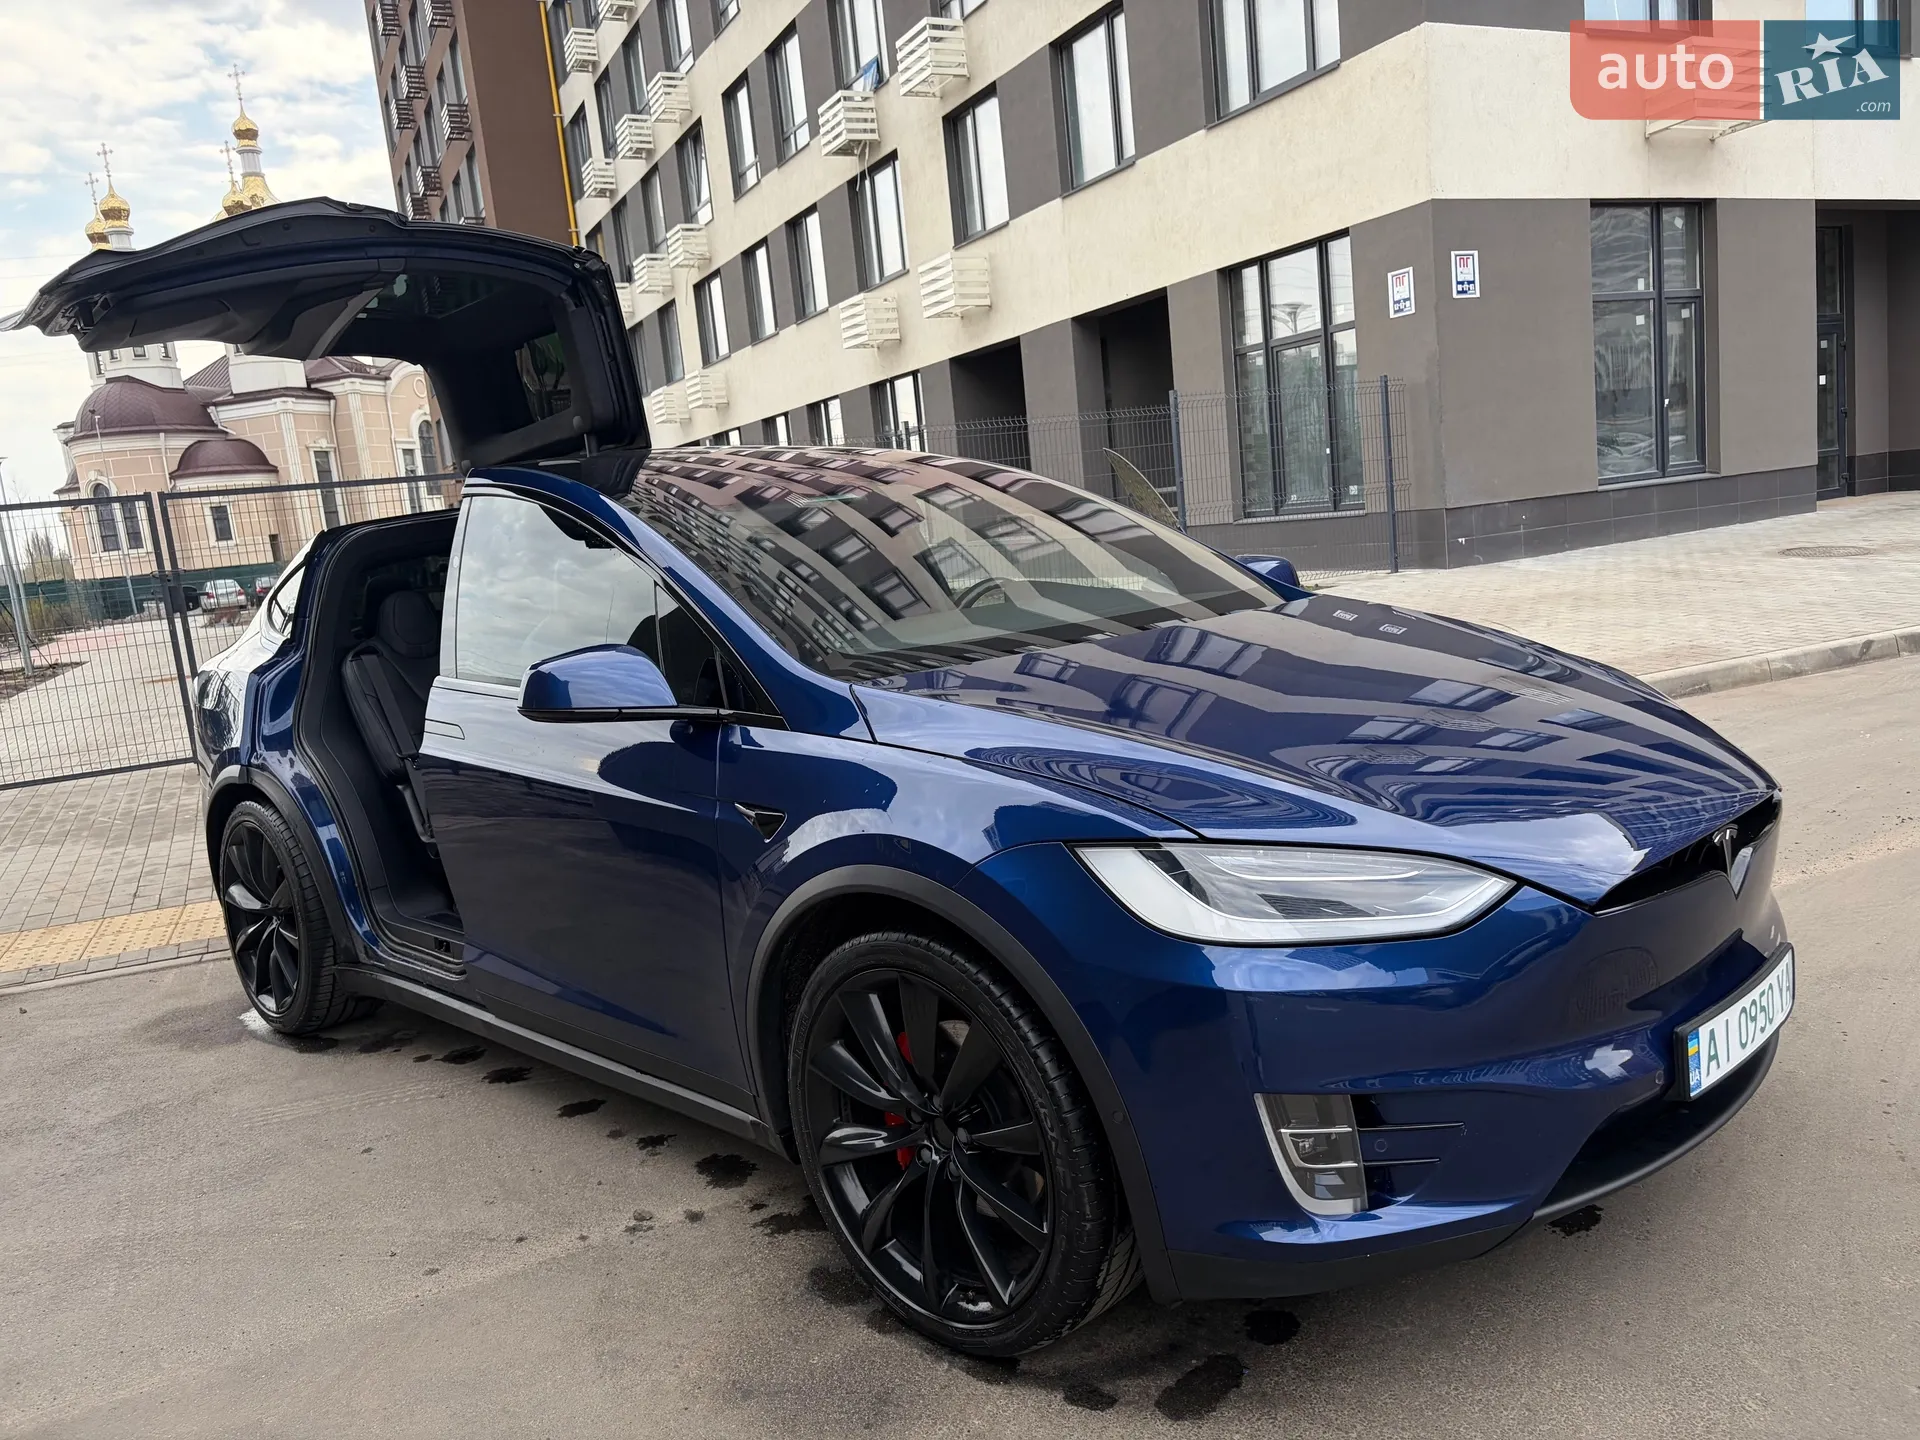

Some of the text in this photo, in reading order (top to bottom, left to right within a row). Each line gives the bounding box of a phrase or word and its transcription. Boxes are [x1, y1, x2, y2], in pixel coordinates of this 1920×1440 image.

[1459, 257, 1471, 268] ПГ
[1706, 962, 1791, 1078] AI 0950 YA
